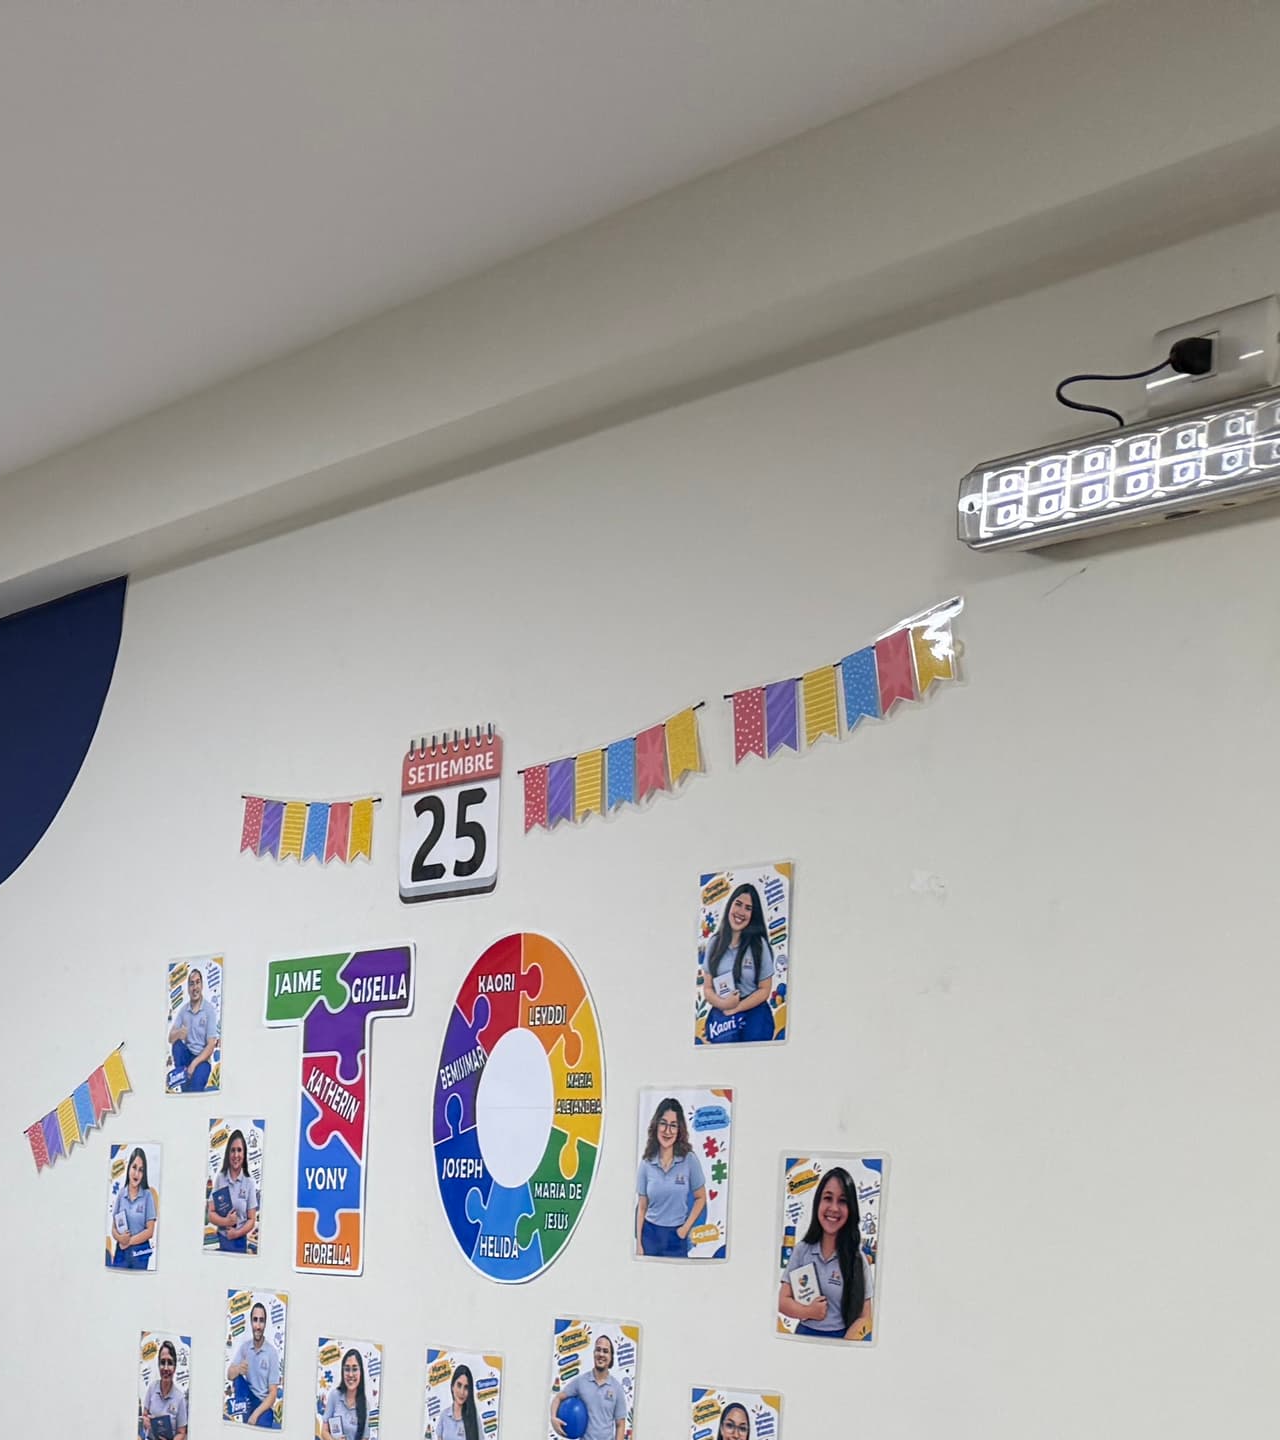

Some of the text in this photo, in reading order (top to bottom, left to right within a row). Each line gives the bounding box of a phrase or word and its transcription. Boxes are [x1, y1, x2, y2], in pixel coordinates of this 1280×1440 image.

[408, 752, 494, 785] SETIEMBRE
[411, 787, 487, 882] 25
[274, 969, 322, 997] JAIME
[351, 973, 407, 1003] GISELLA
[478, 973, 515, 993] KAORI
[529, 1005, 567, 1026] LEYDDI
[709, 1016, 736, 1038] Kaori
[306, 1066, 361, 1123] KATHERIN
[305, 1167, 348, 1190] YONY
[442, 1158, 483, 1180] JOSEPH
[534, 1182, 582, 1199] MARIA DE
[544, 1209, 568, 1229] JESÚS
[303, 1243, 352, 1265] FIORELLA
[480, 1236, 519, 1258] HELIDA
